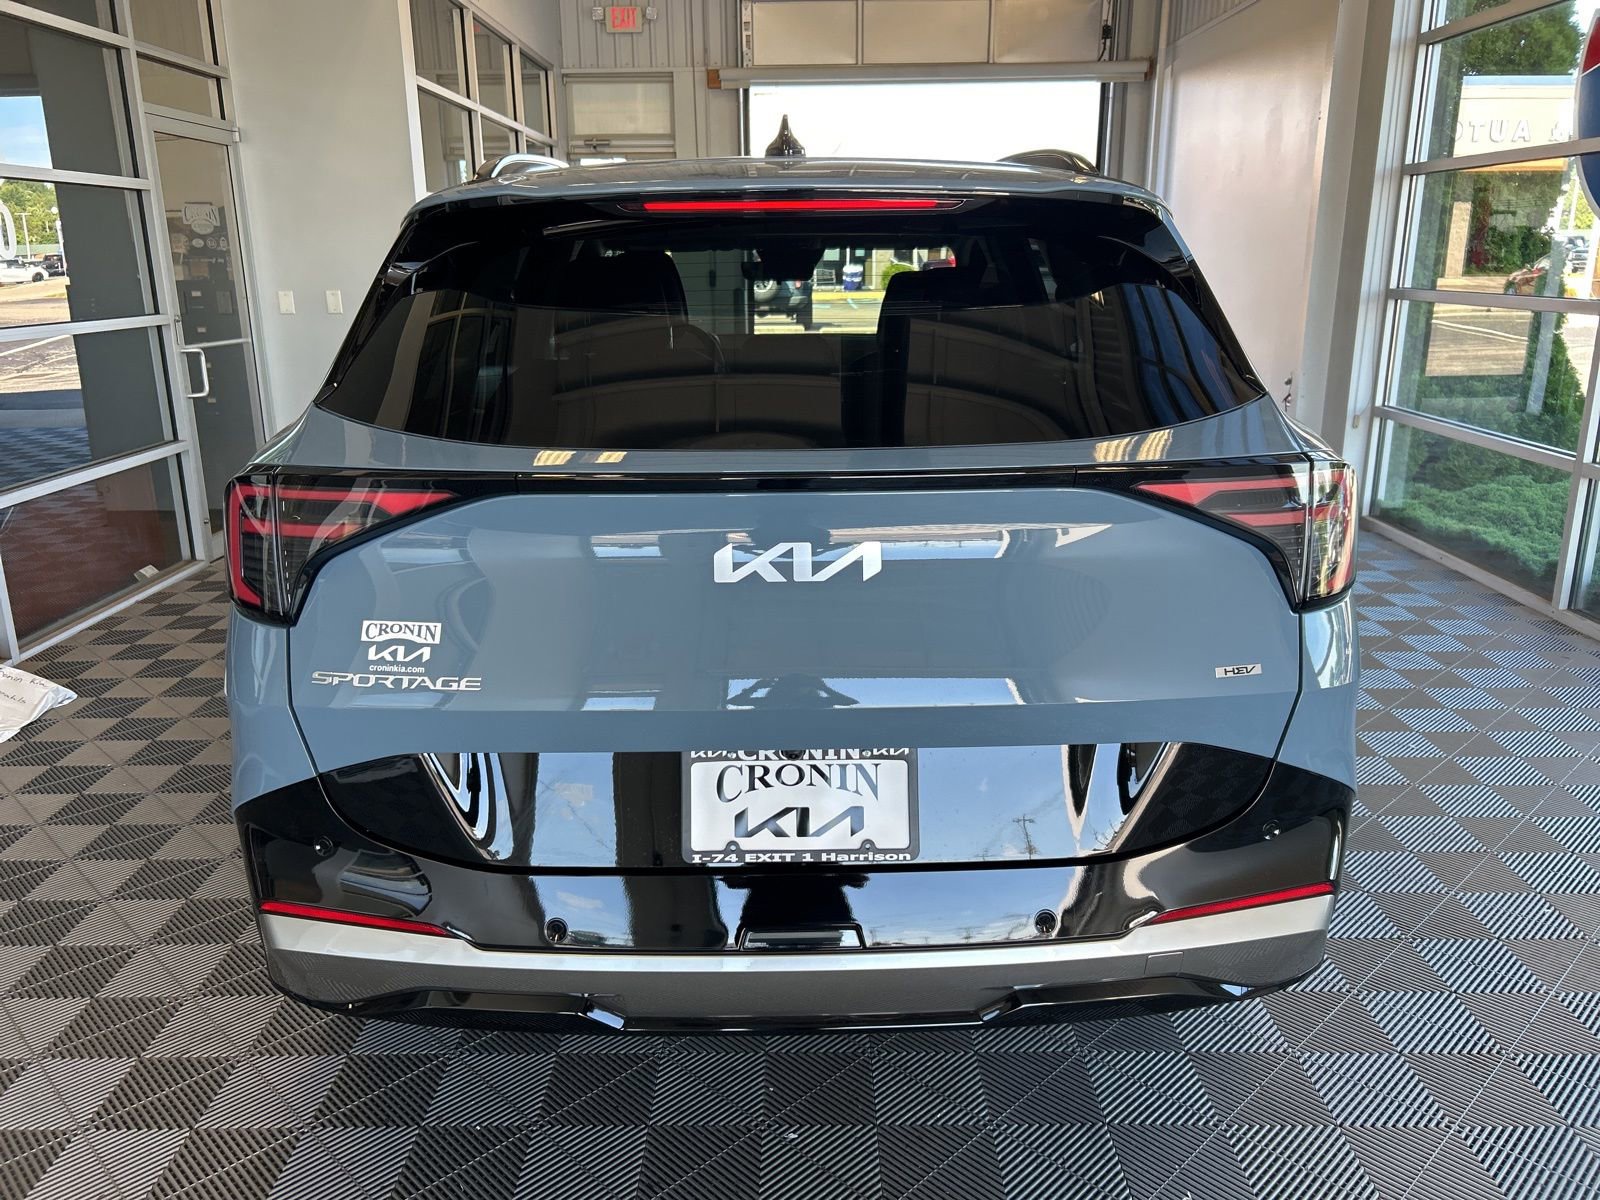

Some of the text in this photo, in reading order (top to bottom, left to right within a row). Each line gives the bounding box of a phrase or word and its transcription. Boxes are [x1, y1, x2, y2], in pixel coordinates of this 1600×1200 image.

[611, 7, 637, 29] EXIT
[713, 541, 882, 583] KIA
[365, 622, 438, 642] CRONIN
[367, 644, 431, 663] KIA
[369, 664, 425, 673] croninkia.com
[1223, 665, 1256, 676] HEV
[311, 671, 482, 691] SPORTAGE
[716, 763, 882, 803] CRONIN
[734, 806, 865, 838] KIA
[692, 851, 911, 863] I-74 EXIT 1 Harrison
